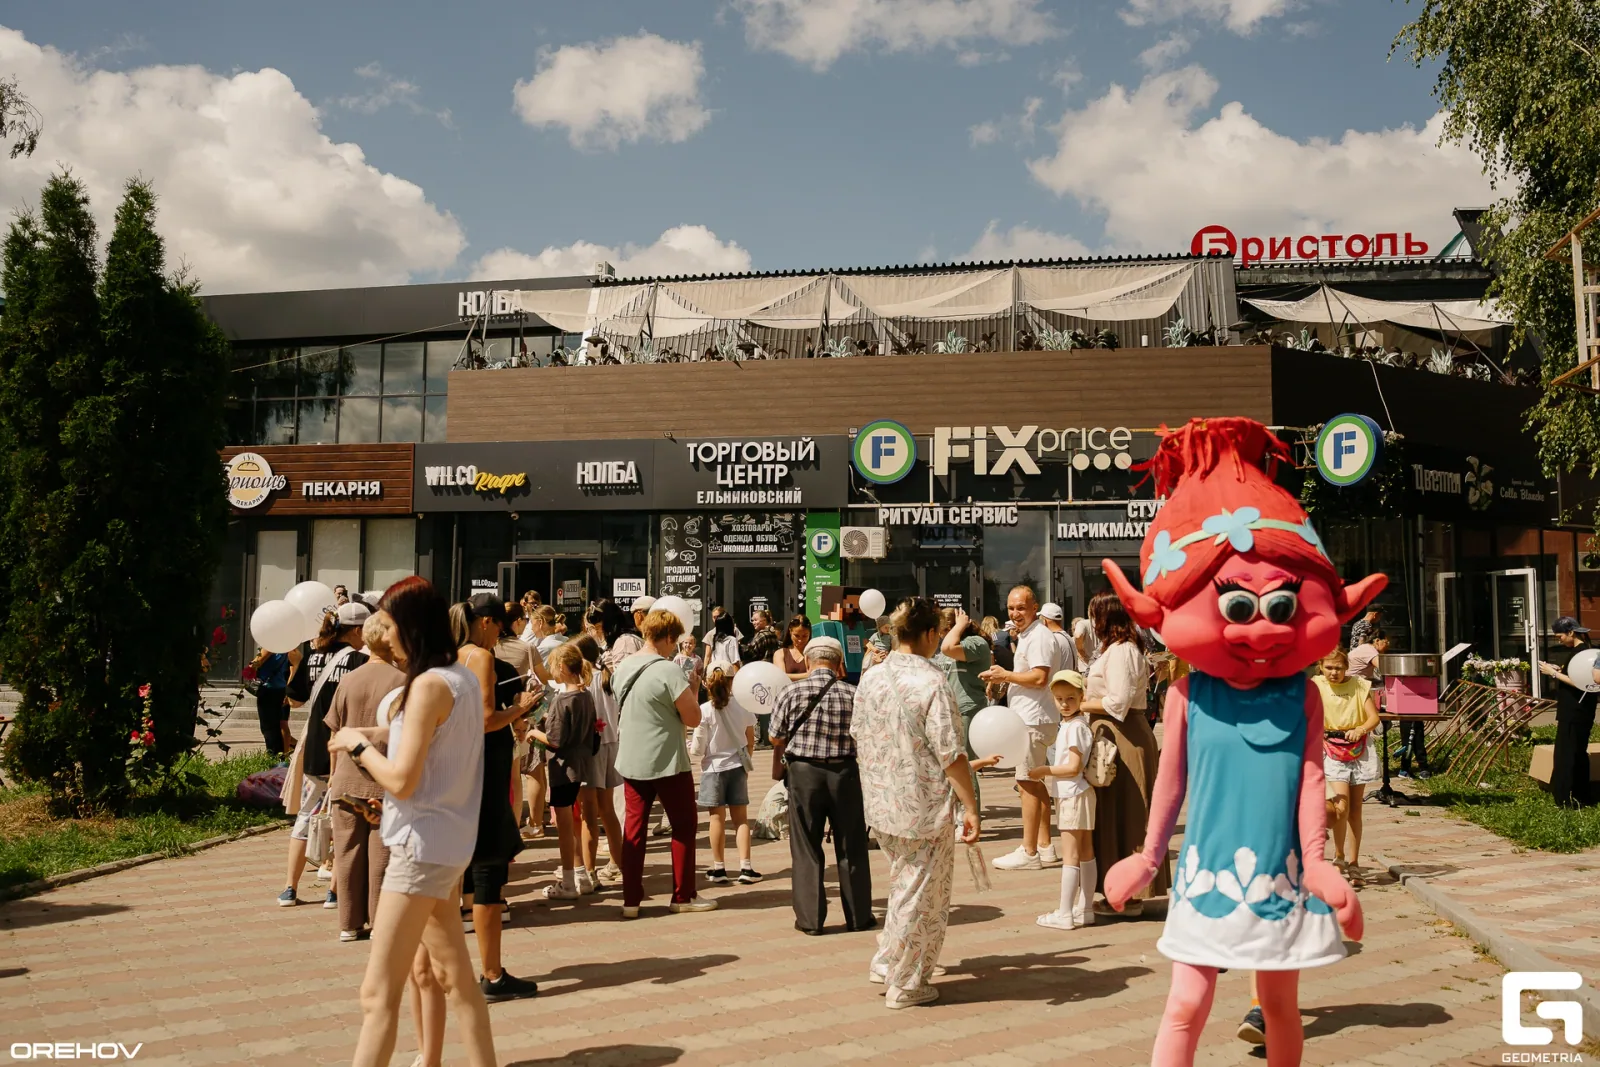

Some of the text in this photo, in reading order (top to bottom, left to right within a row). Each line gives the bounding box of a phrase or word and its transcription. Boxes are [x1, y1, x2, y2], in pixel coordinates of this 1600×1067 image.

[1192, 225, 1428, 268] Бристоль
[687, 437, 815, 463] ТОРГОВЫЙ
[872, 436, 896, 468] F
[1038, 427, 1131, 457] price
[1333, 431, 1356, 469] F
[425, 465, 477, 486] WILCO
[576, 461, 638, 484] КОЛБА
[716, 464, 788, 487] ЦЕНТР
[302, 481, 380, 496] ПЕКАРНЯ
[697, 487, 802, 504] ЕЛЬНИКОВСКИЙ
[878, 506, 1018, 525] РИТУАЛ СЕРВИС
[723, 535, 753, 543] ОДЕЖДА
[663, 566, 700, 574] ПРОДУКТЫ
[666, 575, 696, 583] ПИТАНИЯ
[617, 582, 642, 592] КОЛБА
